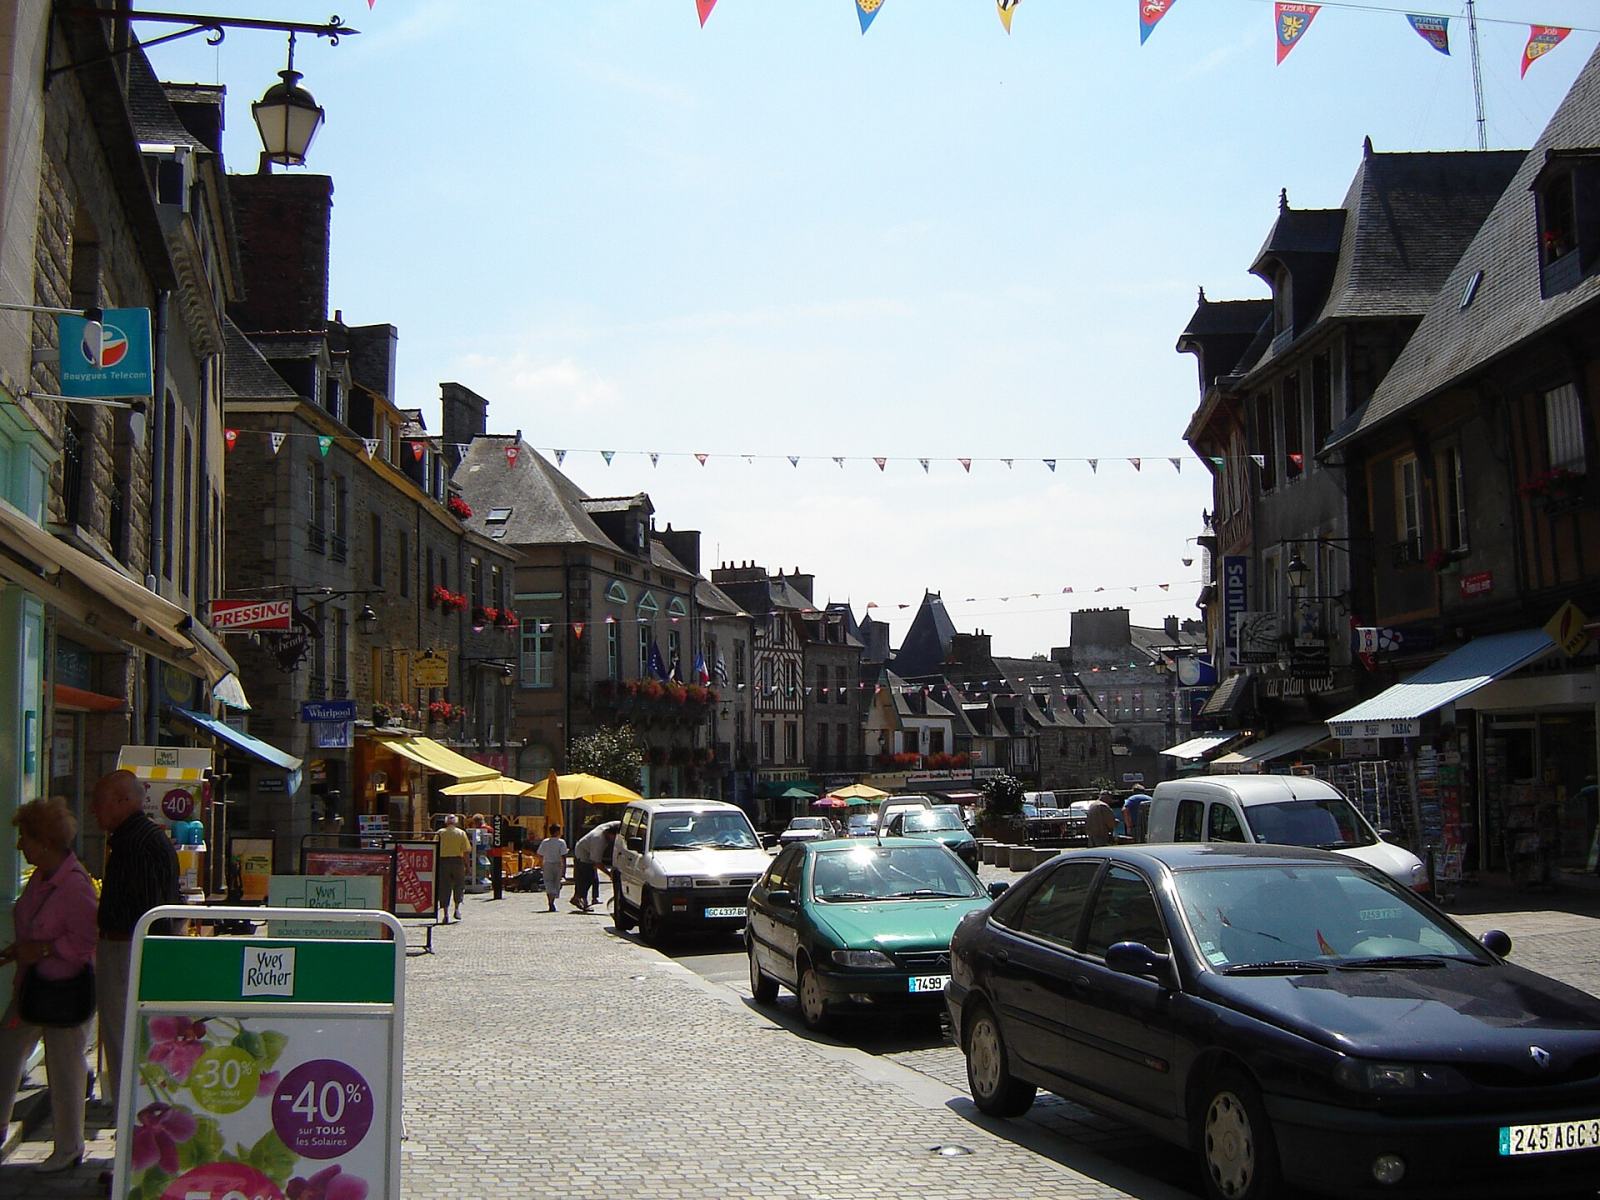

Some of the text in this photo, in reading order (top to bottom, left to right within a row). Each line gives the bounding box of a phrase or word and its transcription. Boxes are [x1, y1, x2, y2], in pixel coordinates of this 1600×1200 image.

[63, 371, 147, 382] Bouygues Telecom
[213, 601, 289, 627] PRESSING
[1283, 678, 1305, 702] pain
[309, 707, 351, 719] Whirlpool
[1391, 723, 1412, 735] TABAC
[315, 886, 335, 899] Yves
[257, 951, 284, 972] Yves
[247, 967, 292, 987] Rocher
[915, 977, 942, 990] 7499
[298, 1126, 346, 1135] sur TOUS
[296, 1137, 347, 1146] les Solaires
[1515, 1127, 1548, 1152] 245
[1555, 1123, 1586, 1149] AGC
